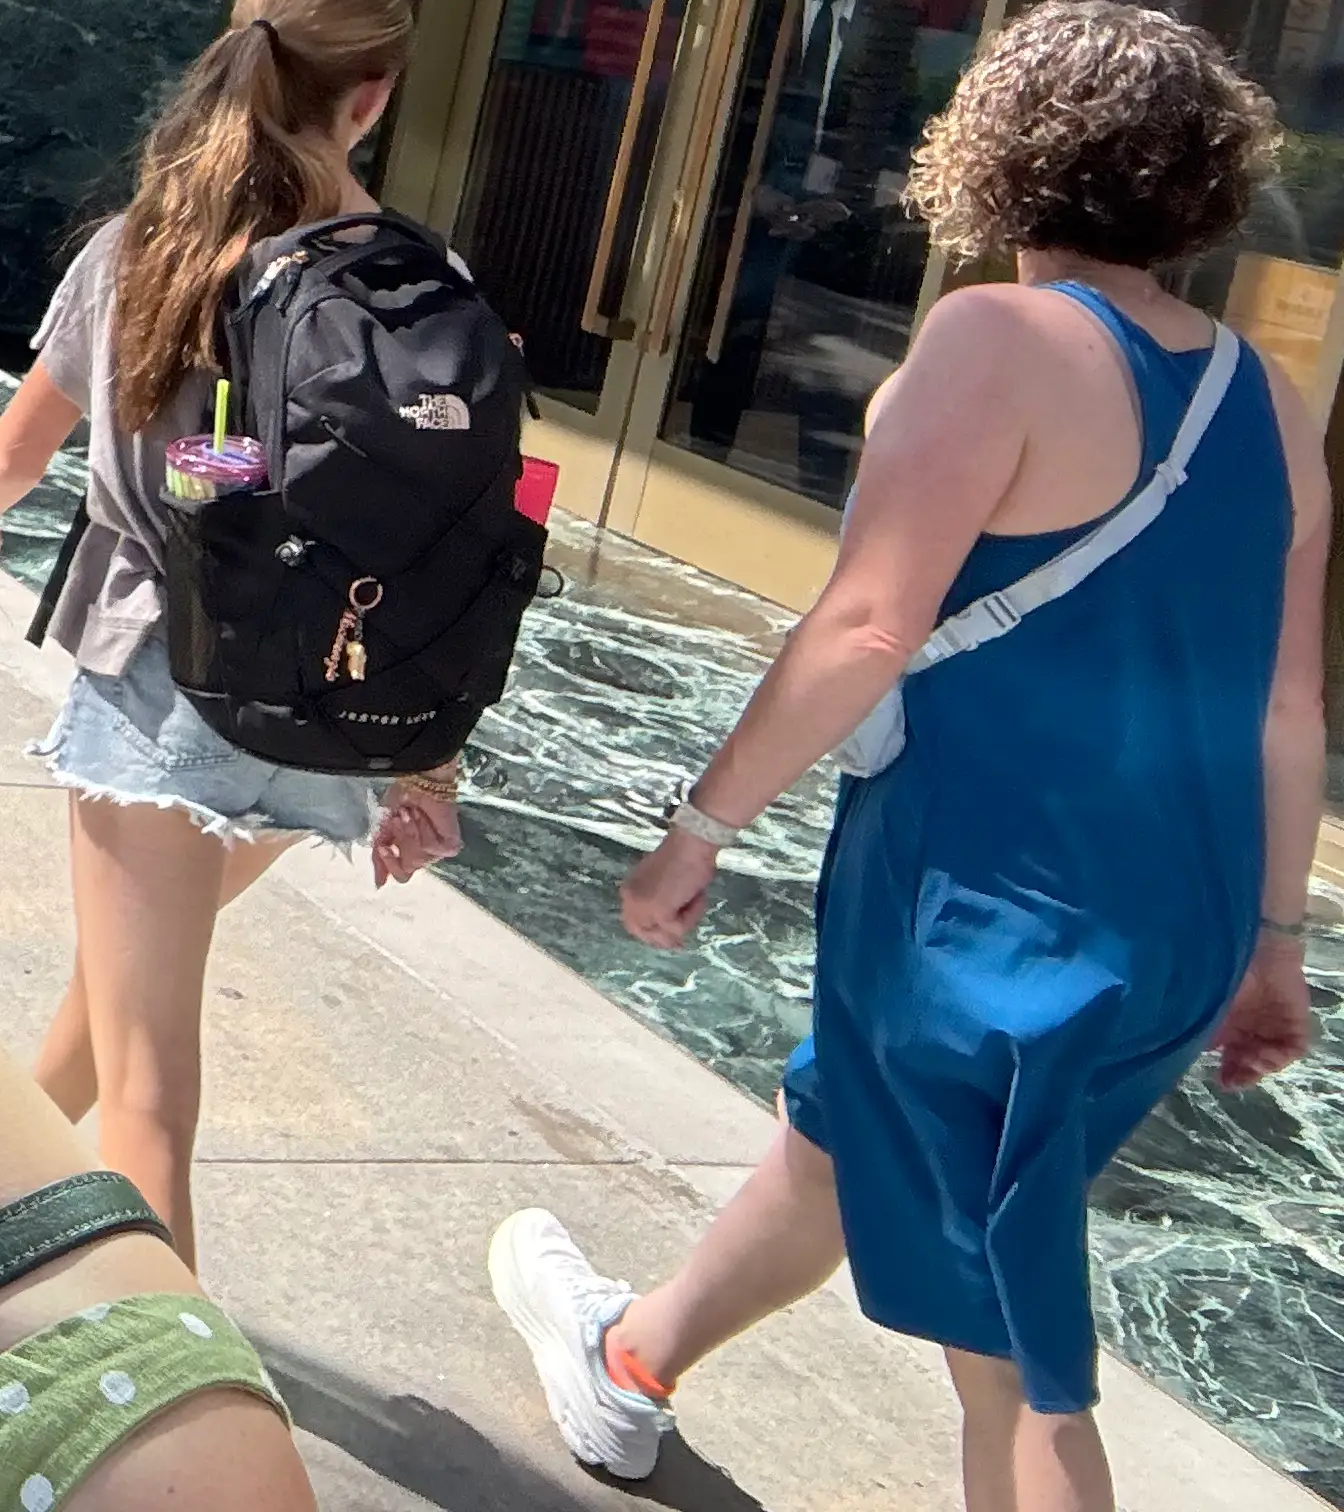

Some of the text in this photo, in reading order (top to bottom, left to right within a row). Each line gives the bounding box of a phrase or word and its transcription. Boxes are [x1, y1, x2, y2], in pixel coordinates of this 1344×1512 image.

[419, 393, 447, 408] THE
[399, 406, 449, 419] NORTH
[415, 418, 450, 430] FACE
